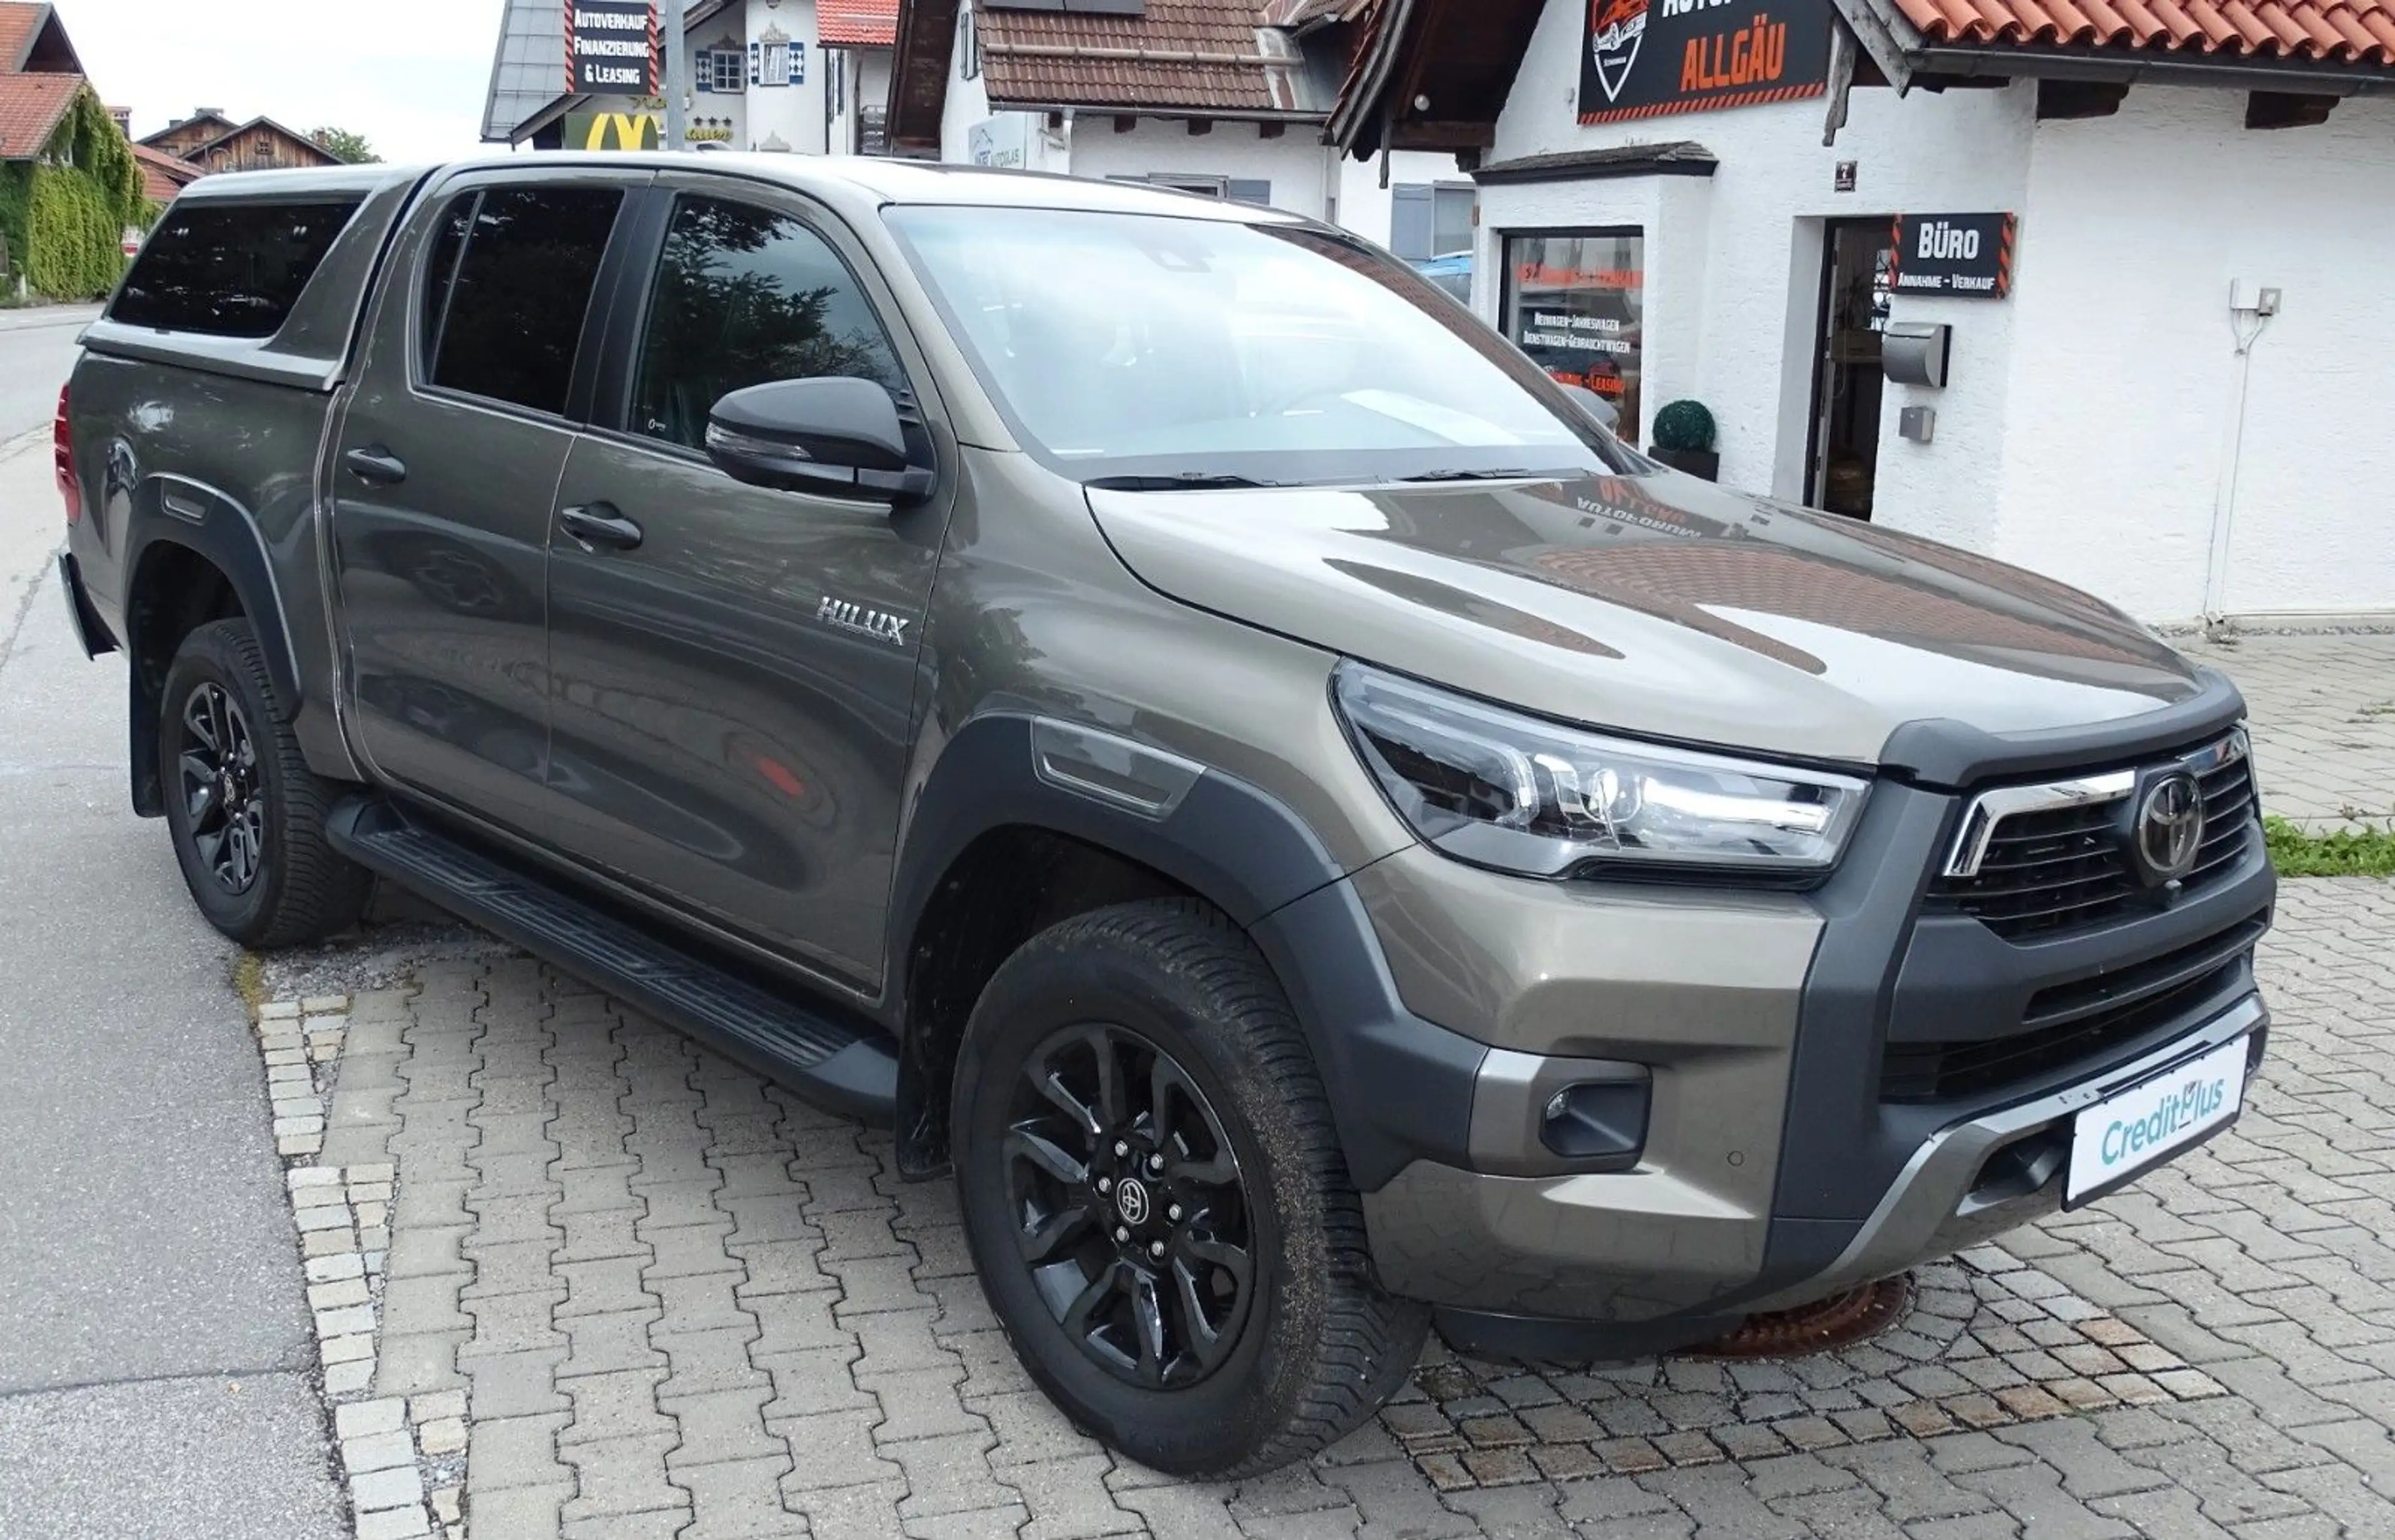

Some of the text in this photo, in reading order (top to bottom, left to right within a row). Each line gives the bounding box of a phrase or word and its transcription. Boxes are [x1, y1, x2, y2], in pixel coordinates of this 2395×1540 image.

[574, 9, 648, 30] AUTOVERKAUF
[574, 36, 649, 57] FINANZIERUNG
[1681, 13, 1786, 92] ALLGÄU
[585, 64, 640, 84] & LEASING
[1917, 221, 1979, 259] BÜRO
[1898, 273, 1942, 288] ANNAHME
[1952, 274, 1995, 289] VERKAUF
[816, 596, 909, 646] HILUX
